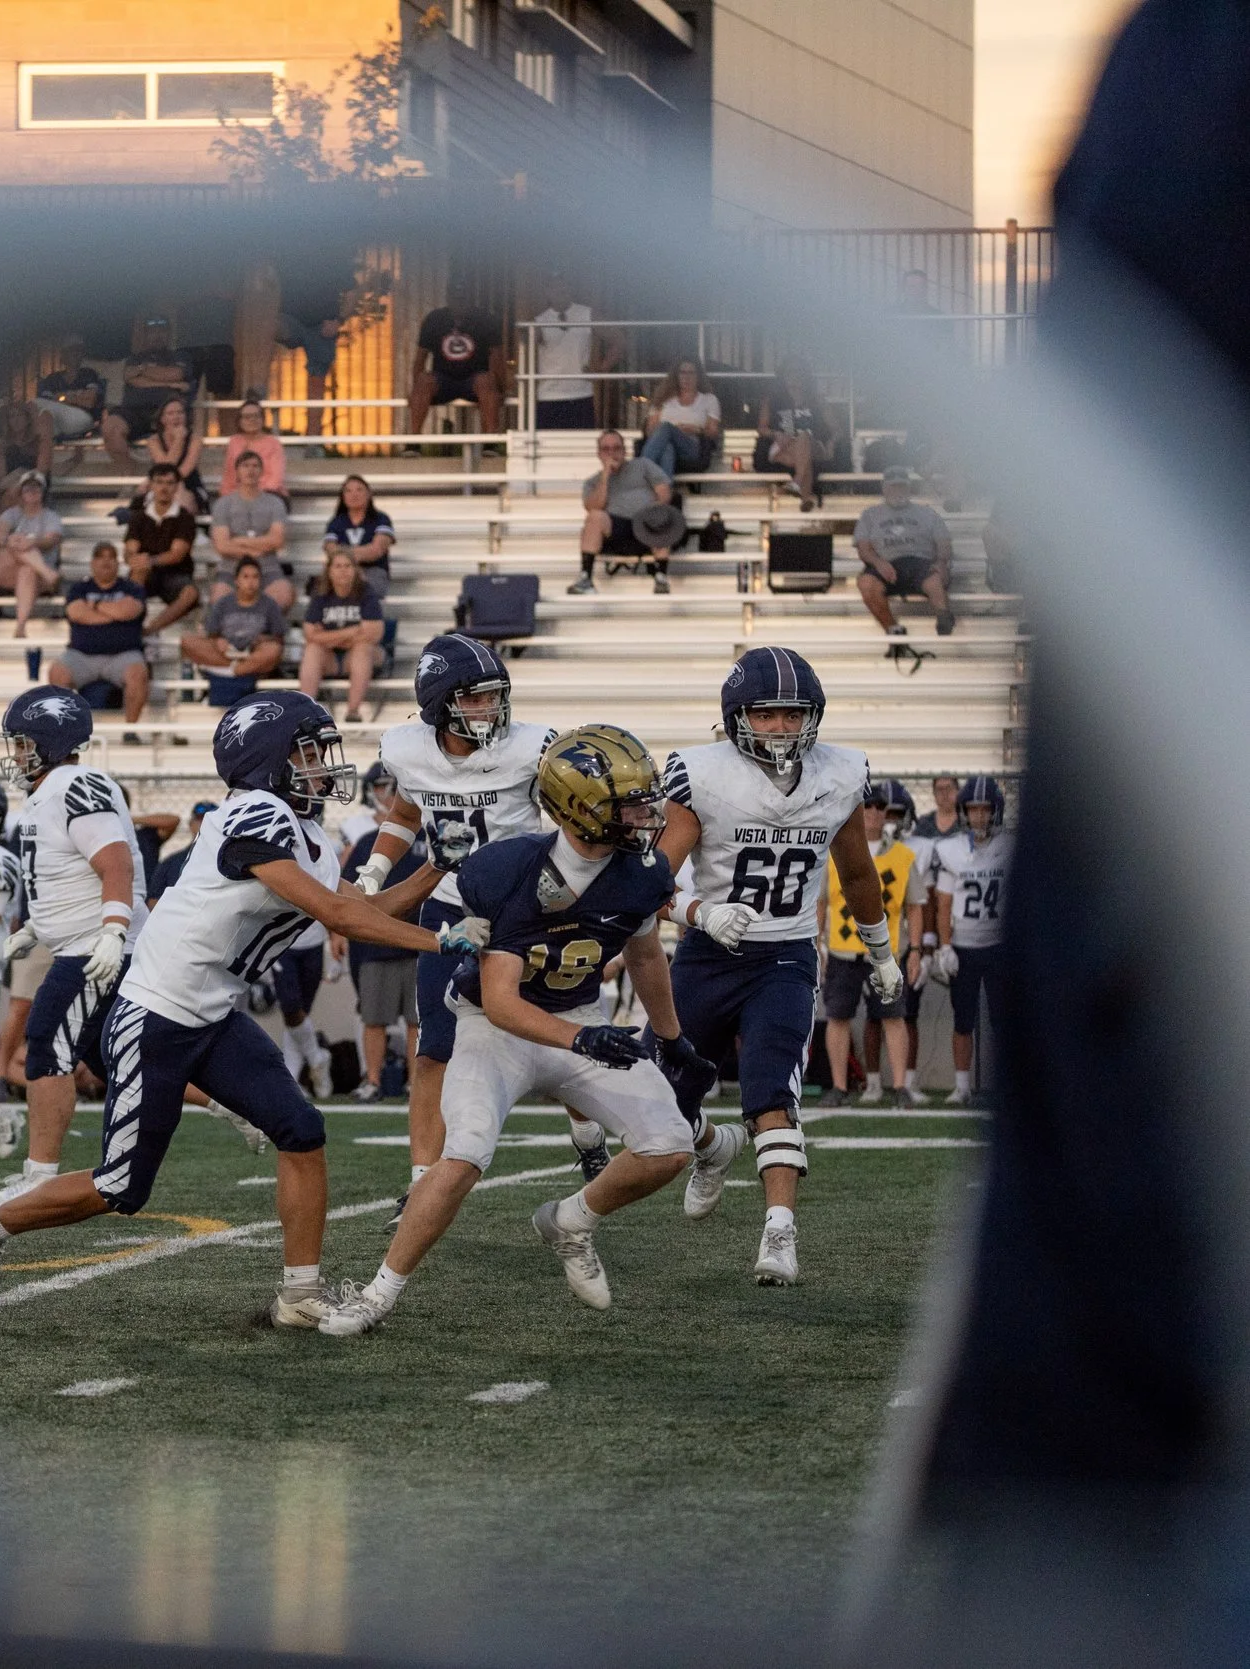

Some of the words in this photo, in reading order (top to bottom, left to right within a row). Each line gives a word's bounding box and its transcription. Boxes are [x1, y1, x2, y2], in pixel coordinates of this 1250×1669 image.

[421, 793, 447, 807] VISTA
[450, 795, 468, 807] DEL
[470, 791, 498, 808] LAGO
[735, 828, 767, 843] VISTA
[771, 829, 792, 844] DEL
[797, 830, 828, 845] LAGO
[727, 847, 817, 917] 60
[963, 880, 1000, 919] 24
